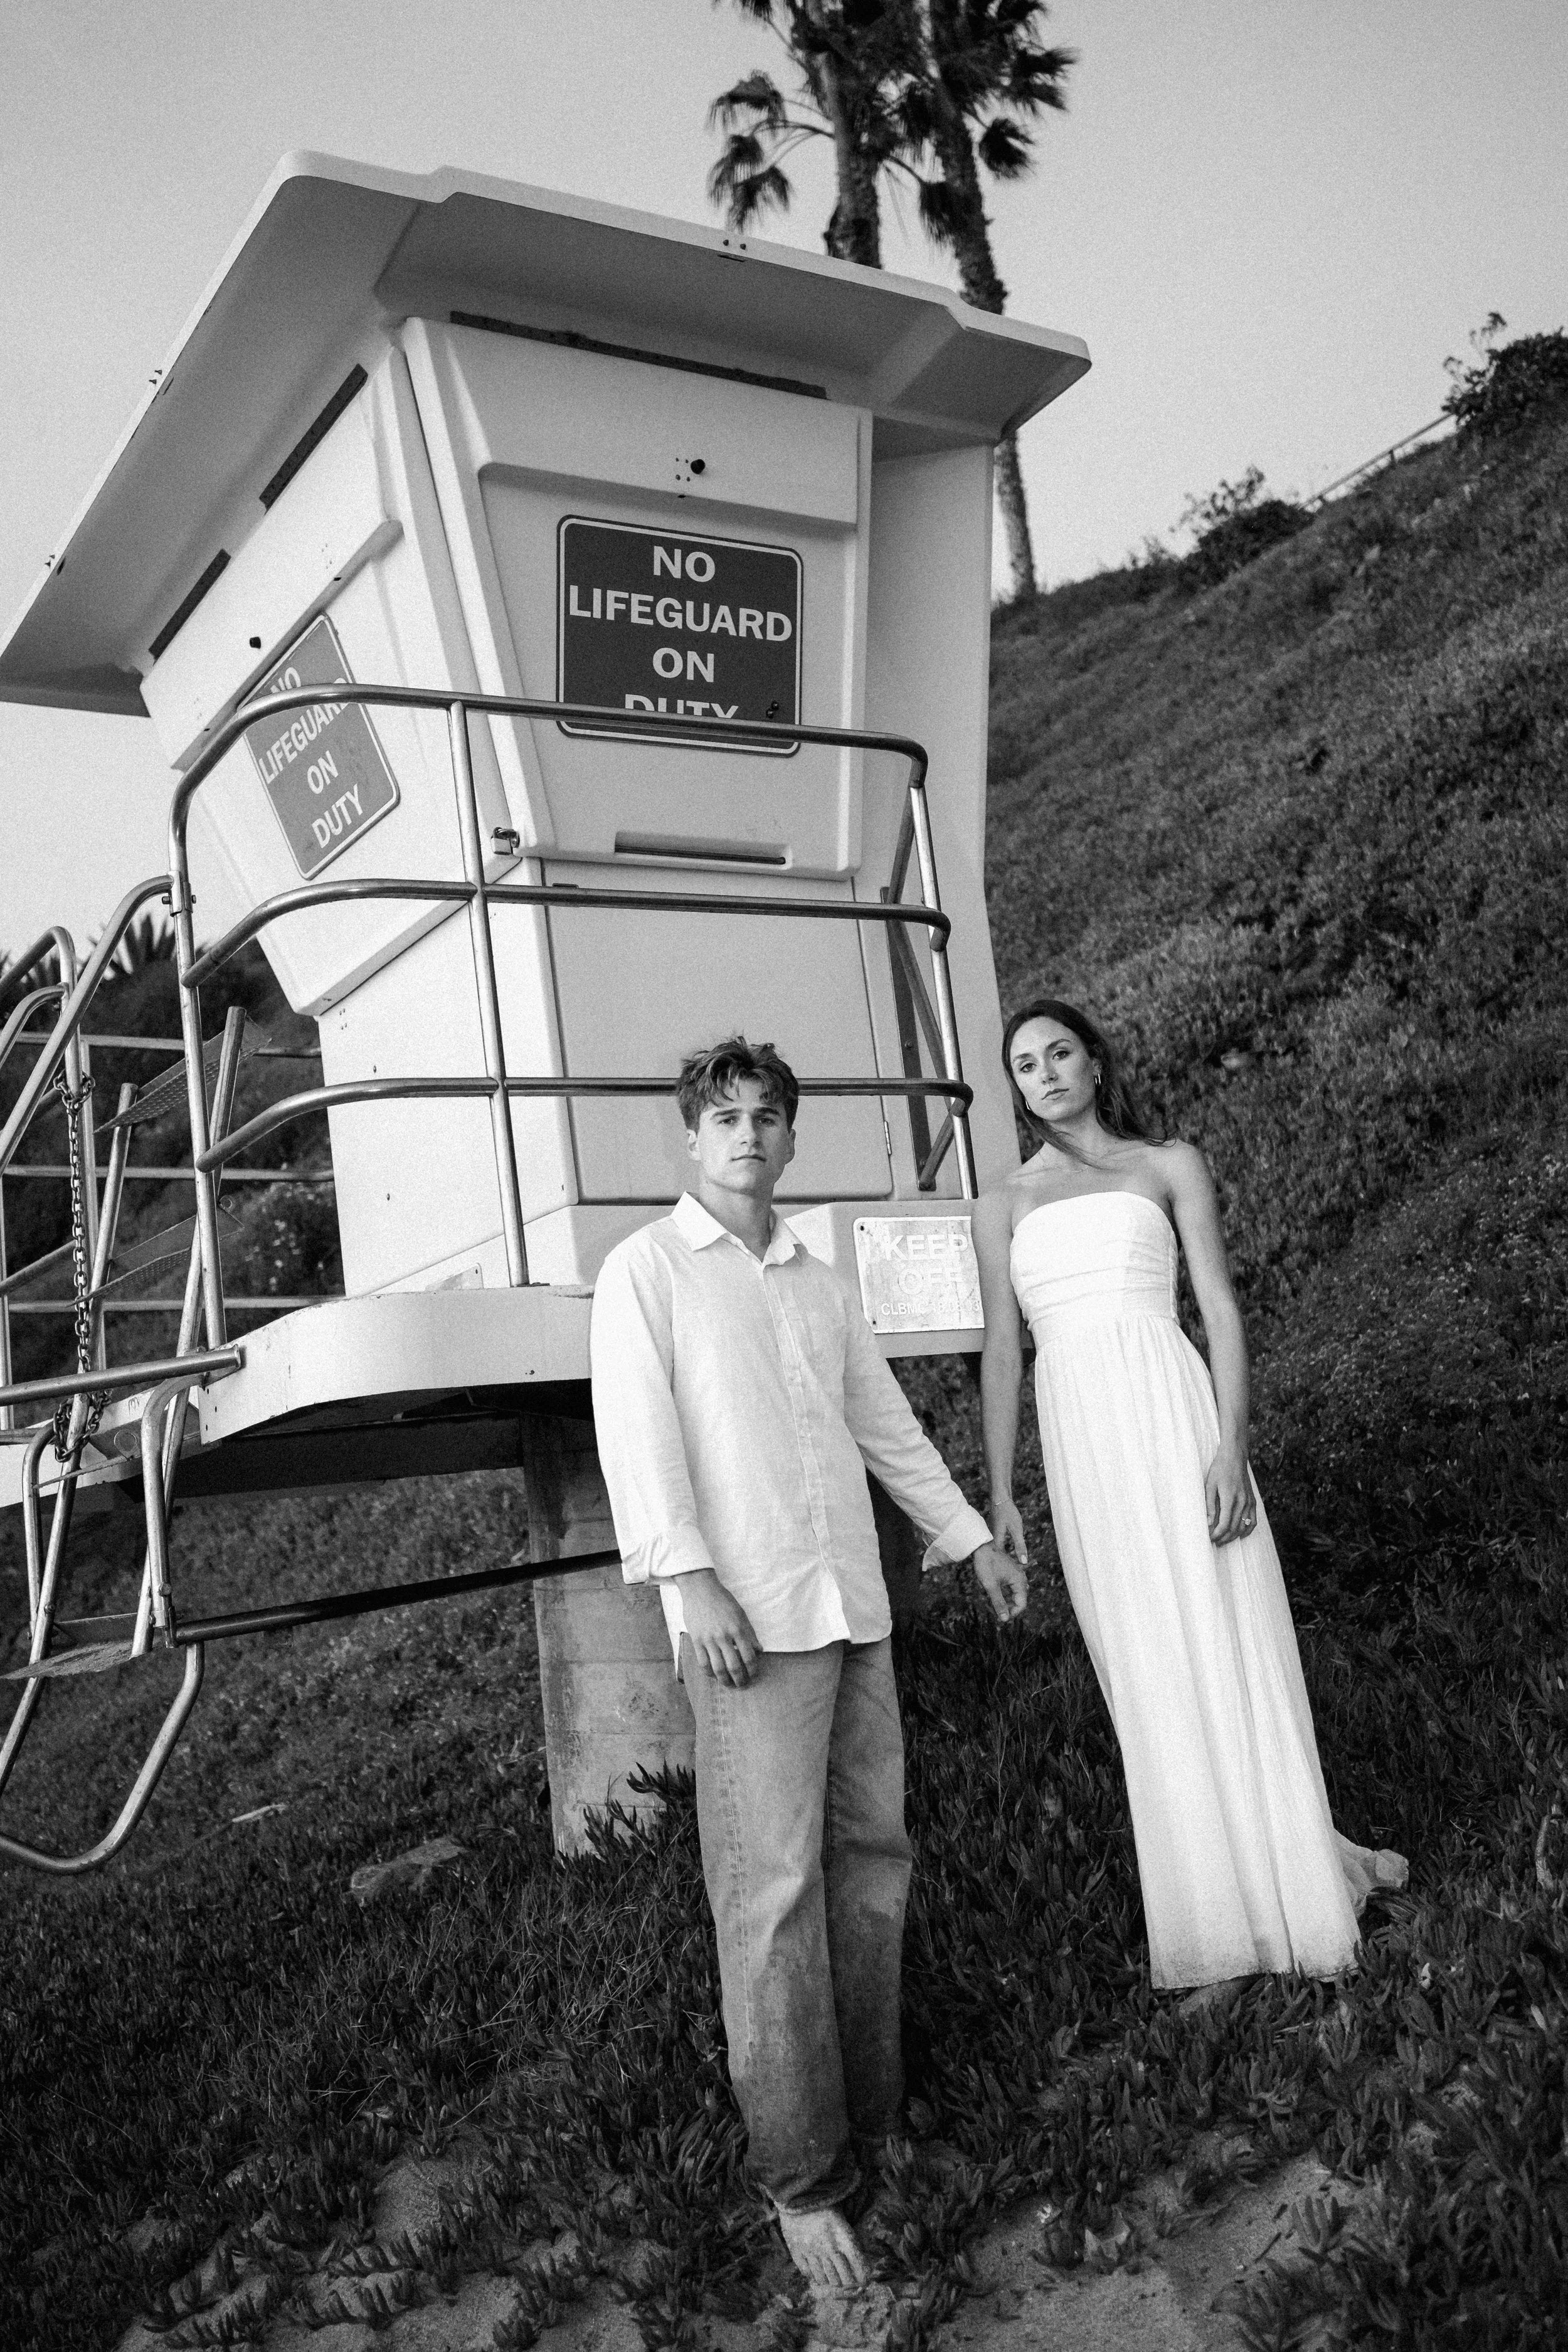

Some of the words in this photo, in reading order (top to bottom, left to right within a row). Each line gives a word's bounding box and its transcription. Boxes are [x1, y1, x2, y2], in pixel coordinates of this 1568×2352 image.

[653, 545, 716, 582] NO
[569, 585, 793, 642] LIFEGUARD
[652, 647, 714, 683] ON
[258, 677, 349, 784] LIFEGUAR
[307, 750, 339, 795] ON
[311, 783, 364, 849] DUTY
[883, 1233, 968, 1261] KEEP
[898, 1268, 967, 1296] OFF
